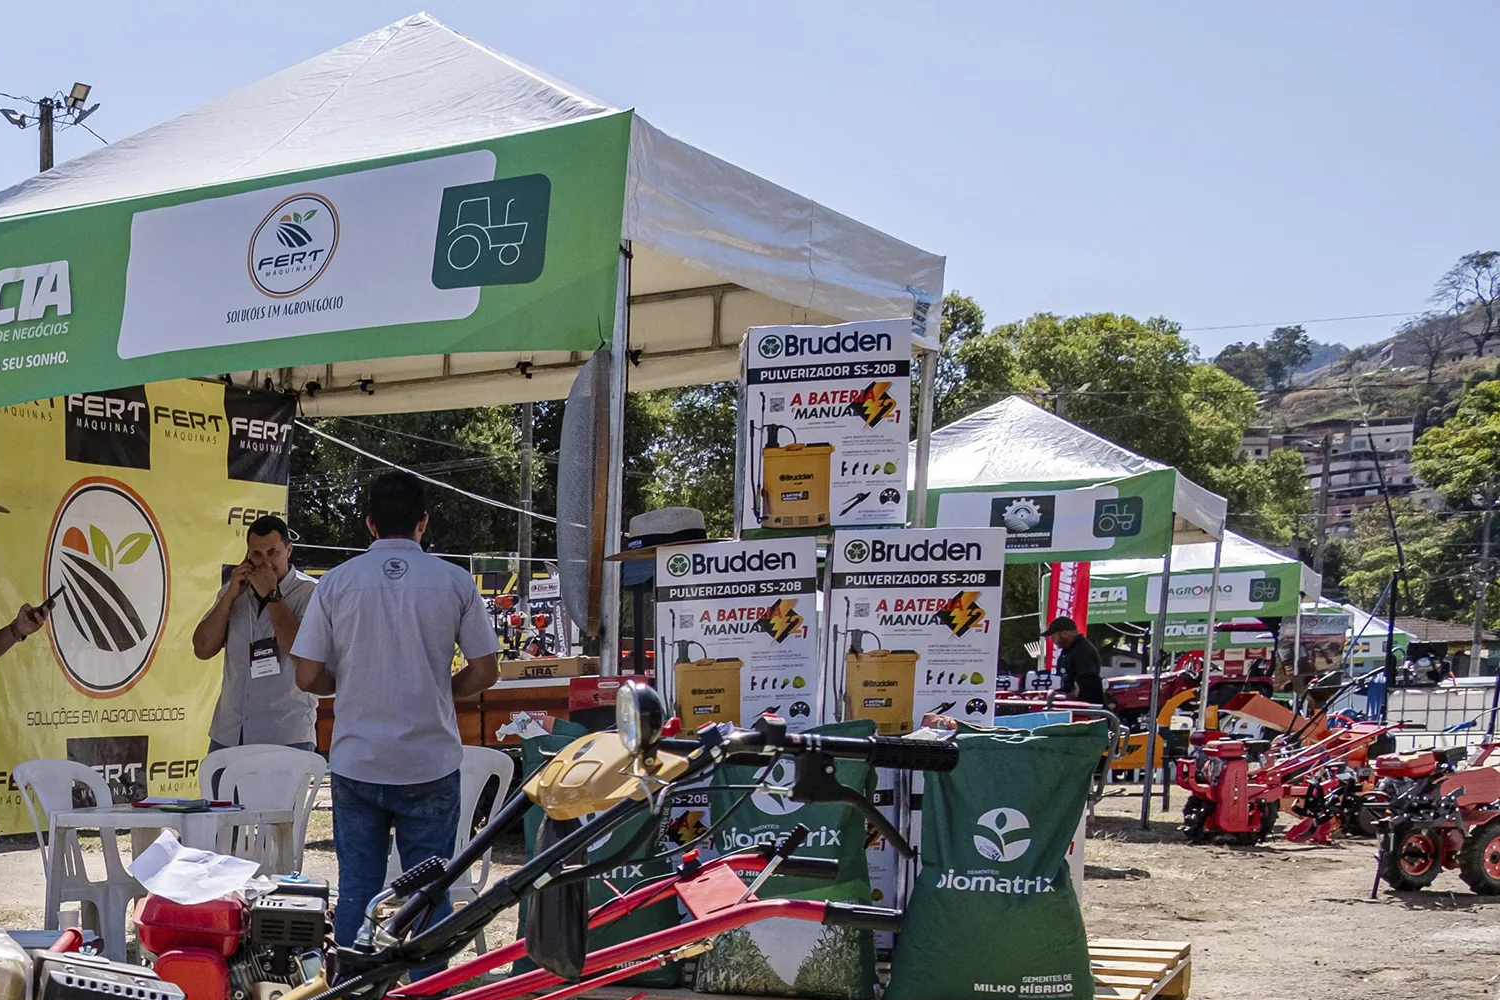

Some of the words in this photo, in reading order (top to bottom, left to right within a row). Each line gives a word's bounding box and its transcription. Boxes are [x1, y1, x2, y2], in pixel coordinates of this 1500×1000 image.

[258, 249, 324, 270] FERT
[268, 304, 281, 318] EM
[12, 322, 70, 341] NEGÓCIOS
[785, 331, 891, 357] Brudden
[2, 356, 23, 371] SEU
[26, 351, 69, 369] SONHO.
[760, 366, 849, 381] PULVERIZADOR
[853, 363, 896, 375] SS-20B
[790, 393, 802, 406] A
[808, 389, 876, 405] BATERIA
[68, 393, 145, 422] FERT
[153, 406, 223, 432] FERT
[231, 417, 292, 442] FERT
[871, 539, 981, 563] Brudden
[692, 550, 796, 575] Brudden
[845, 574, 937, 586] PULVERIZADOR
[941, 573, 986, 584] SS-20B
[669, 584, 756, 599] PULVERIZADOR
[760, 581, 802, 593] SS-20B
[875, 599, 888, 612] A
[894, 598, 964, 612] BATERIA
[700, 610, 711, 623] A
[717, 606, 782, 622] BATERIA
[525, 668, 553, 677] LIRA
[27, 708, 79, 729] SOLUÇÕES
[82, 709, 99, 724] EM
[1022, 974, 1062, 983] SEMENTES
[974, 983, 1017, 994] MILHO
[1019, 983, 1073, 994] HÍBRIDO
